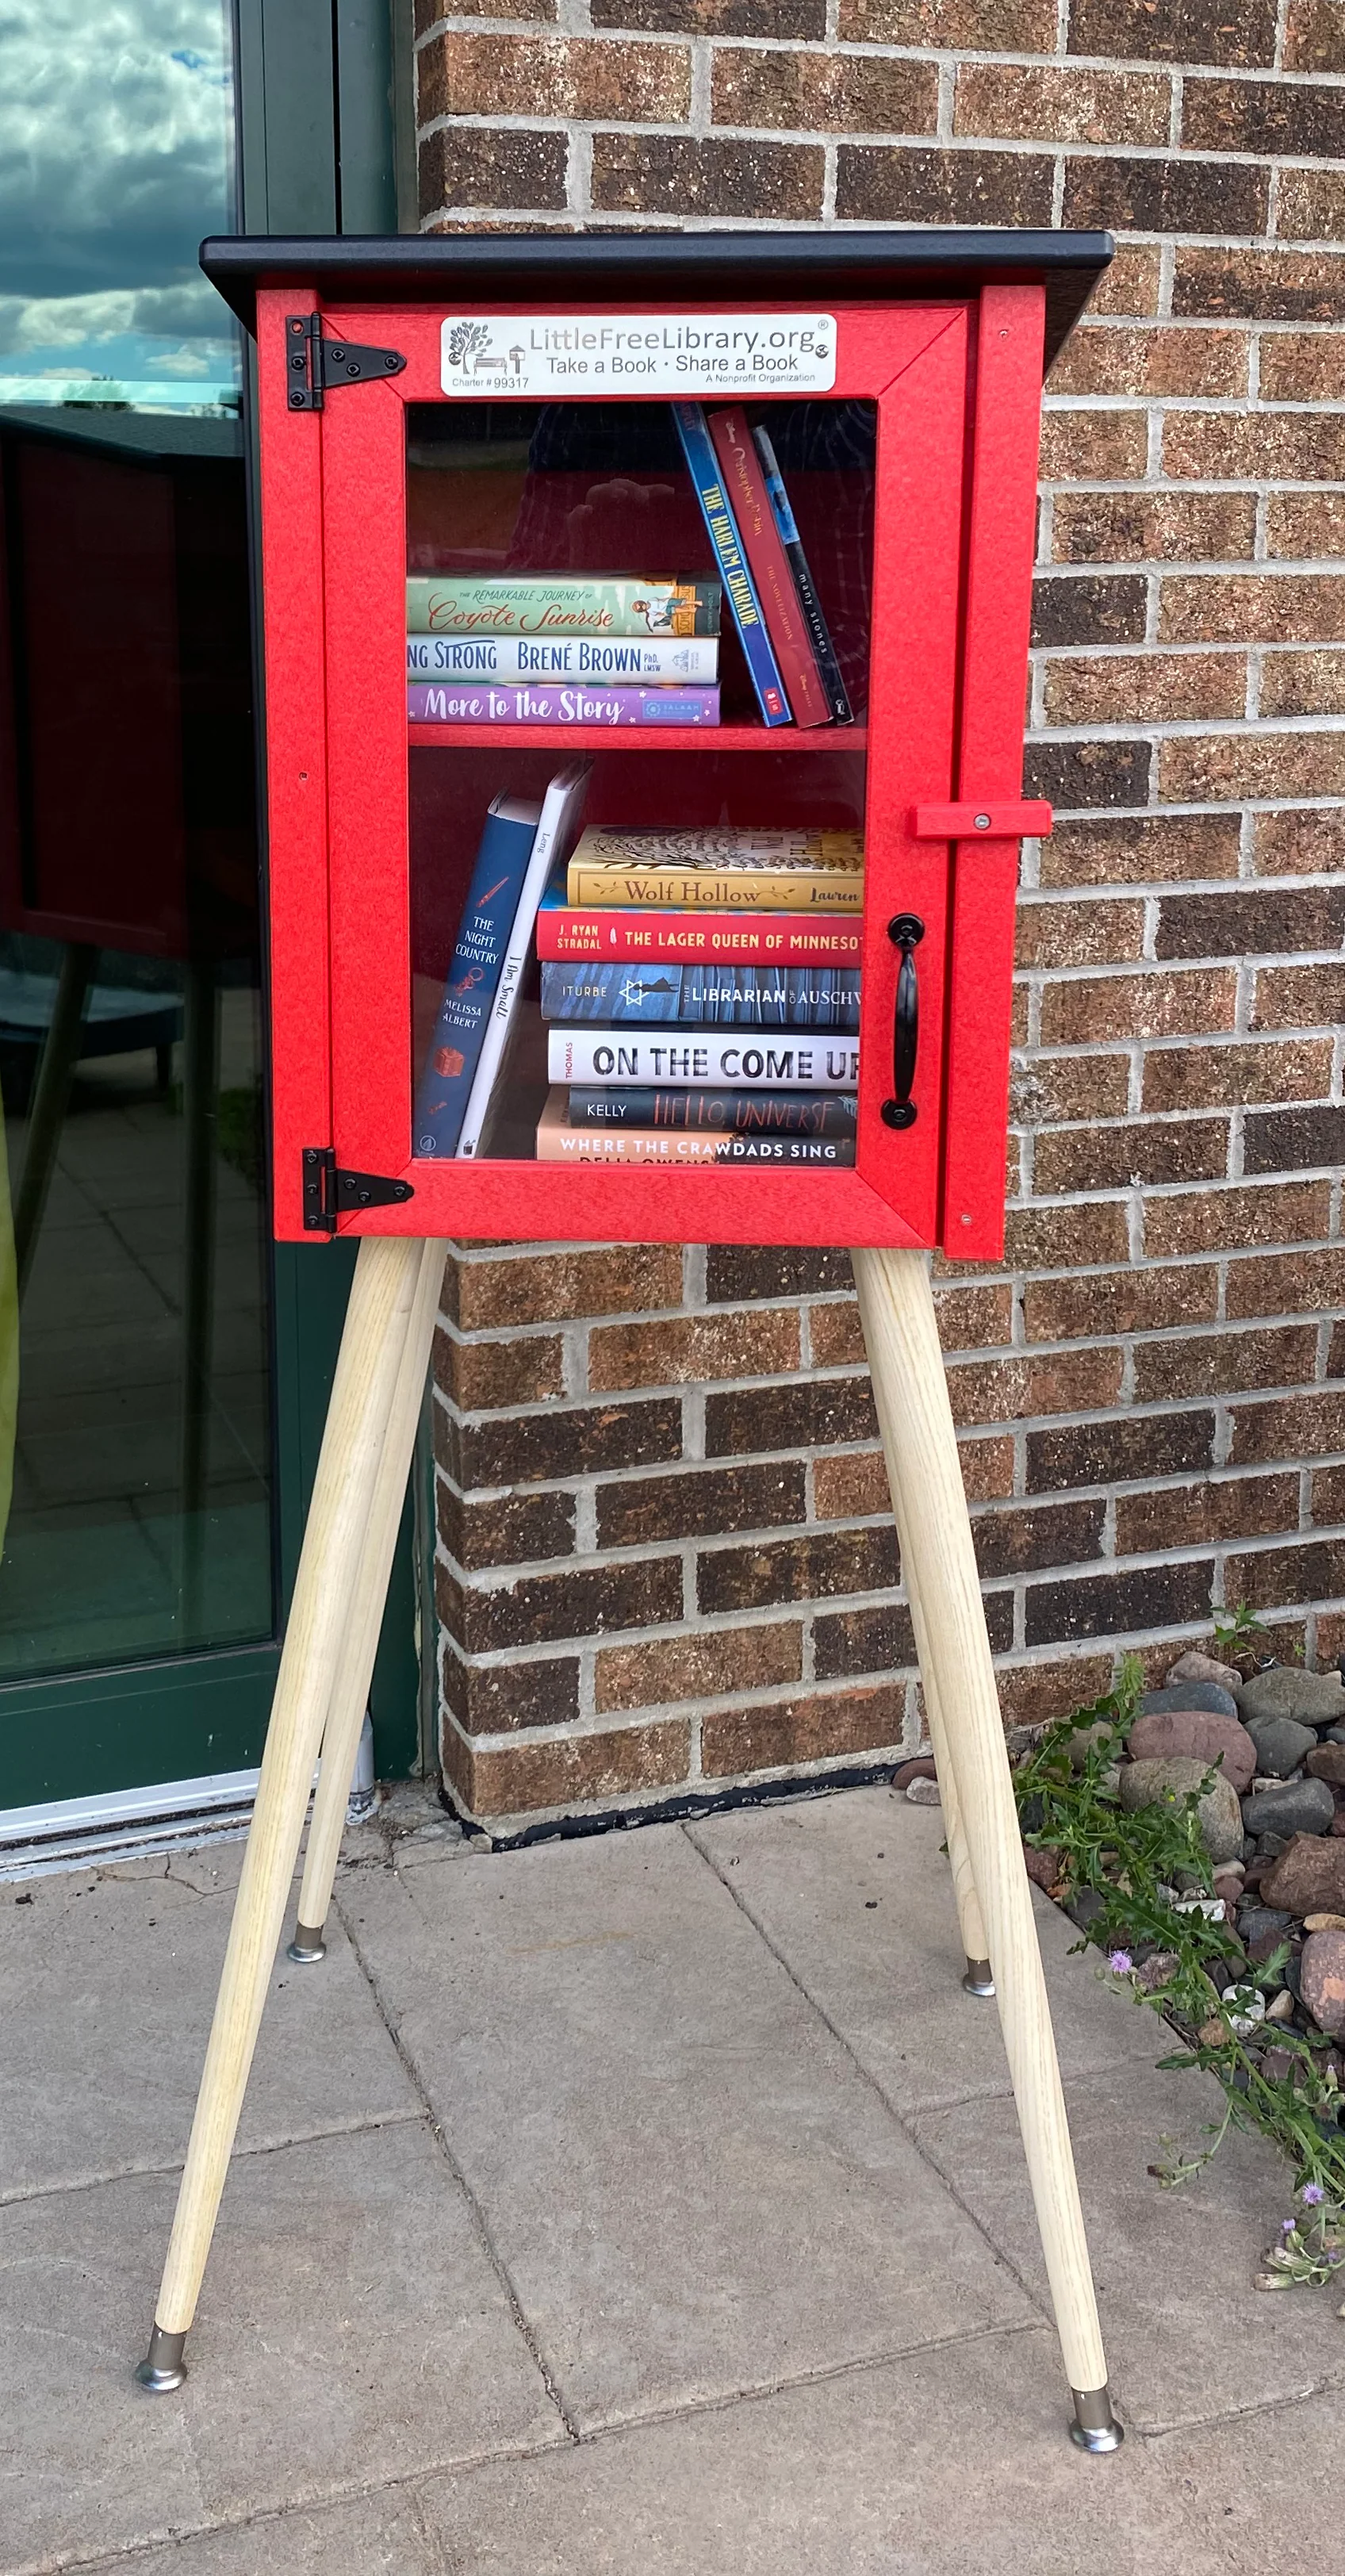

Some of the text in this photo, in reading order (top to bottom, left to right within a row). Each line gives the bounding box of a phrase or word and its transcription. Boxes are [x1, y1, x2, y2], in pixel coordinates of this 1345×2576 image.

[531, 327, 815, 353] LittleFreeLibrary.org
[546, 354, 798, 374] Take a Book Share a Book
[452, 378, 484, 389] Charter
[494, 377, 529, 389] 99317
[716, 374, 756, 384] Nonprofit
[759, 373, 815, 384] Organization
[702, 484, 760, 629] THE HARLEM CHARADE
[473, 589, 535, 604] REMARKABLE
[536, 591, 584, 602] JOURNEY
[428, 592, 615, 632] Coyote Sunrise
[799, 573, 828, 654] many stones
[423, 688, 624, 725] More to the Story
[536, 832, 551, 854] Leng
[624, 880, 860, 903] Wolf Hollow Lauren
[473, 916, 495, 932] THE
[571, 925, 599, 937] RYAN
[465, 930, 496, 948] NIGHT
[557, 937, 602, 950] STRADAL
[625, 931, 652, 946] THE
[657, 933, 706, 947] LAGER
[712, 933, 759, 950] QUEEN
[765, 935, 784, 949] OF
[455, 943, 500, 965] COUNTRY
[505, 964, 519, 982] Am
[496, 984, 515, 1019] Small
[562, 986, 607, 998] ITURBE
[692, 987, 786, 1003] LIBRARIAN
[789, 989, 796, 1005] OF
[444, 999, 482, 1017] MELISSA
[443, 1013, 478, 1029] ALBERT
[565, 1041, 573, 1079] THOMAS
[592, 1045, 639, 1077] ON
[650, 1048, 708, 1077] THE
[719, 1048, 813, 1079] COME
[587, 1104, 627, 1117] KELLY
[560, 1138, 837, 1159] WHERE THE CRAWDADS SING
